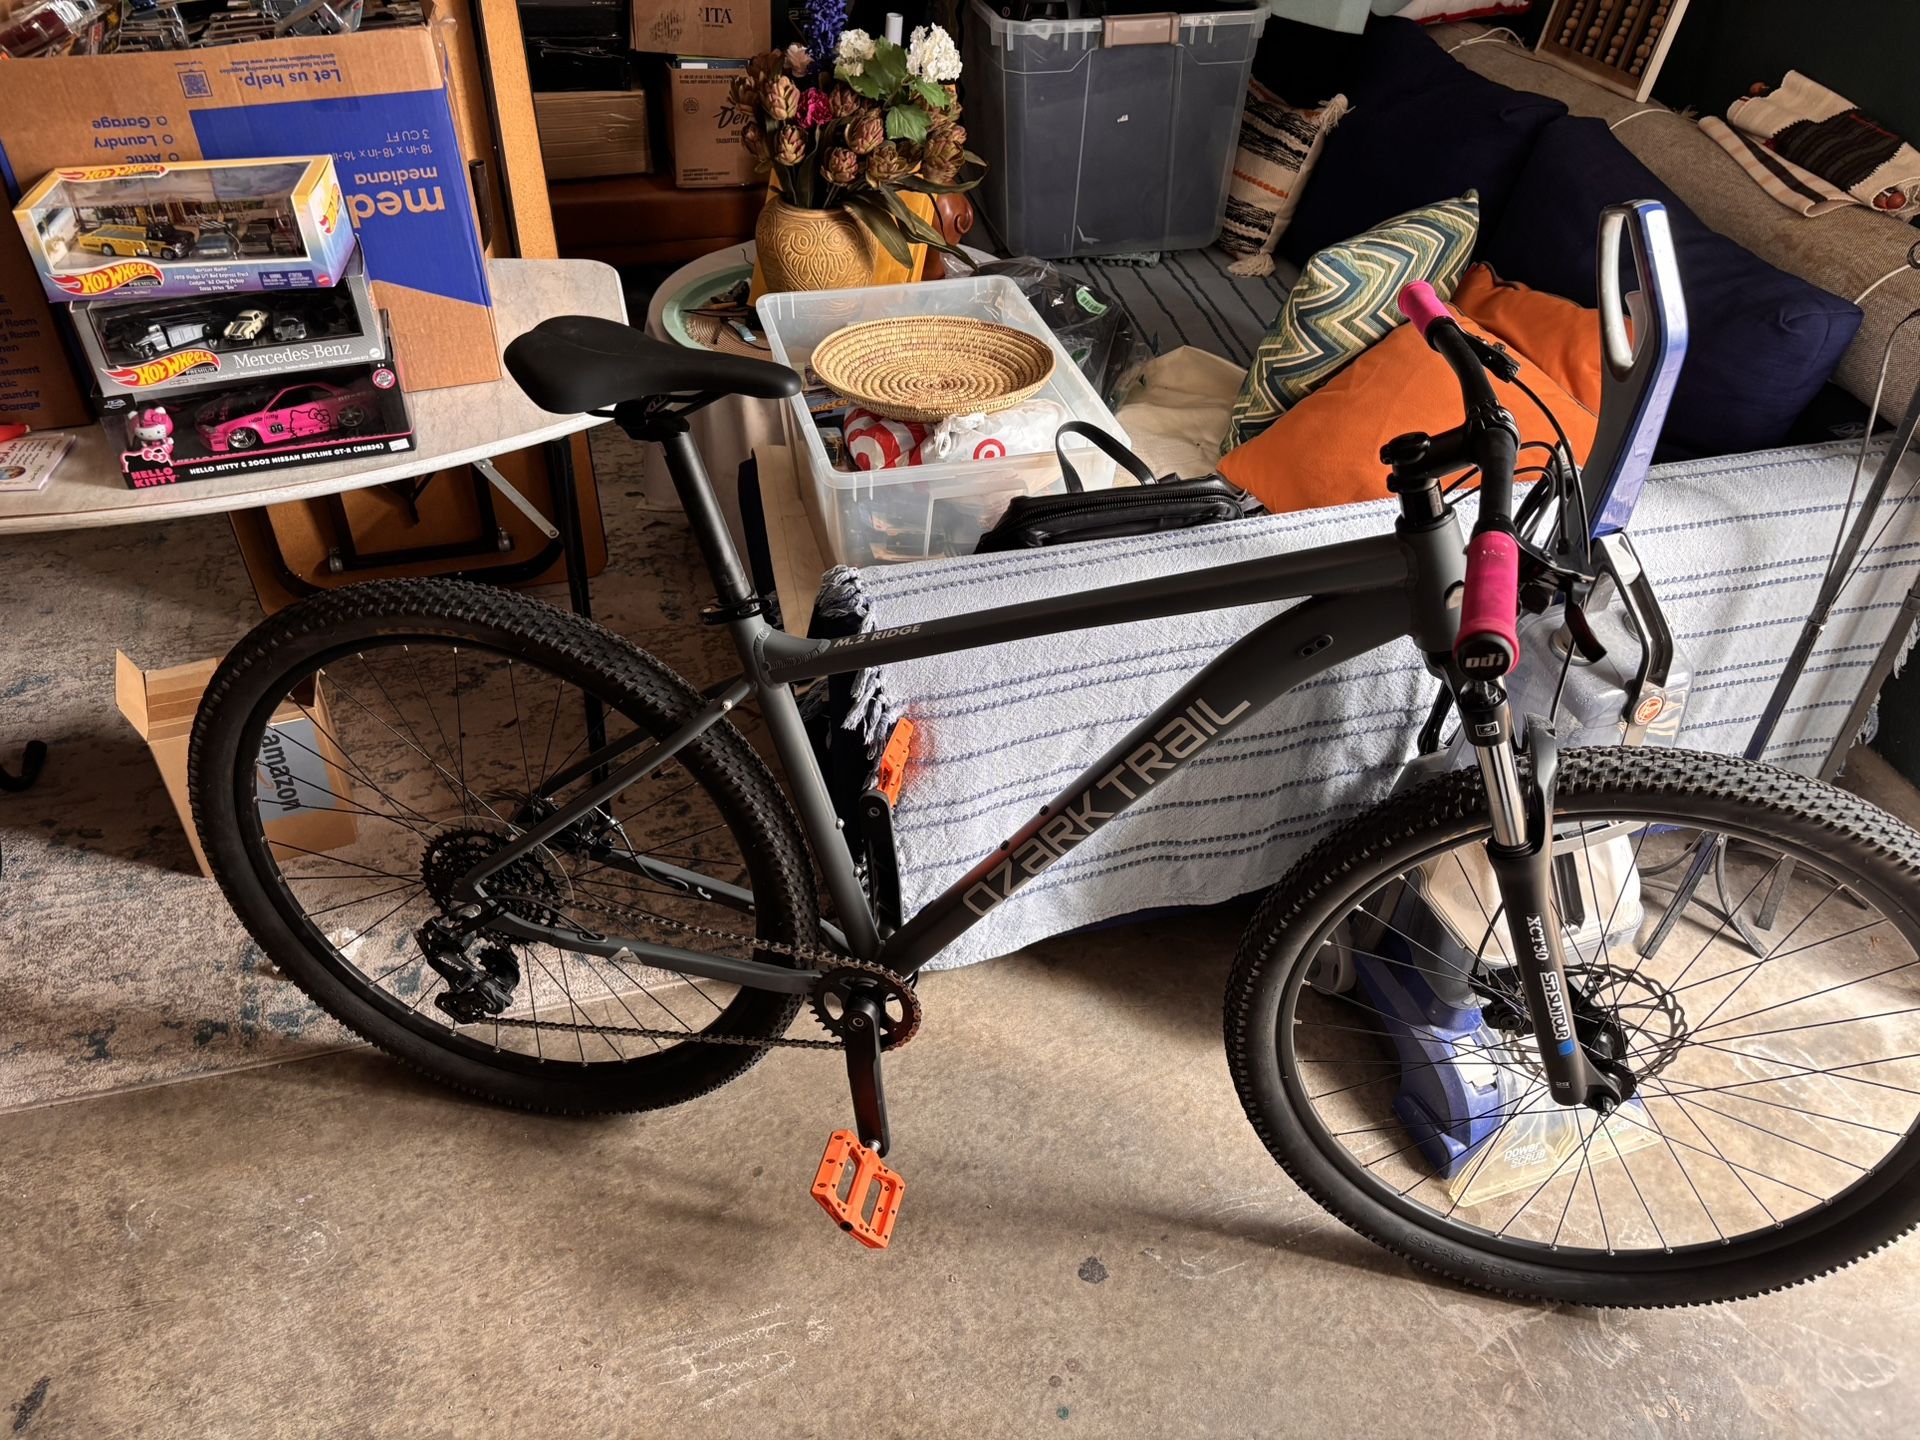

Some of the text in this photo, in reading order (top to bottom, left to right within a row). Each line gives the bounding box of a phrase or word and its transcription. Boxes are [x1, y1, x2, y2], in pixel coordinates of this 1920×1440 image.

[239, 69, 342, 90] Let us help.
[92, 116, 150, 128] Garage
[94, 135, 158, 150] Laundry
[386, 129, 430, 143] 3 CU FT
[126, 153, 161, 164] Attic
[368, 148, 395, 160] 18-in
[397, 146, 404, 154] x
[406, 144, 433, 156] 18-in
[354, 166, 438, 186] mediana
[345, 186, 446, 228] med
[80, 271, 110, 294] HOT
[233, 344, 352, 368] Mercedes-Benz
[0, 365, 40, 376] sement
[134, 363, 168, 385] HOT
[186, 366, 216, 376] PREMIUM
[0, 388, 40, 401] aundry
[190, 466, 214, 474] HELLO
[216, 462, 240, 471] KITTY
[271, 454, 300, 464] NISSAN
[302, 450, 333, 460] SKYLINE
[334, 446, 352, 456] GT-R
[131, 467, 174, 480] HELLO
[134, 474, 177, 488] KITTY
[834, 624, 922, 648] M.2 RIDGE
[1465, 652, 1504, 669] odi
[262, 734, 300, 812] amazon
[963, 698, 1251, 916] OZARK TRAIL
[1526, 915, 1550, 960] XCT30
[1511, 1151, 1546, 1169] SCRUB
